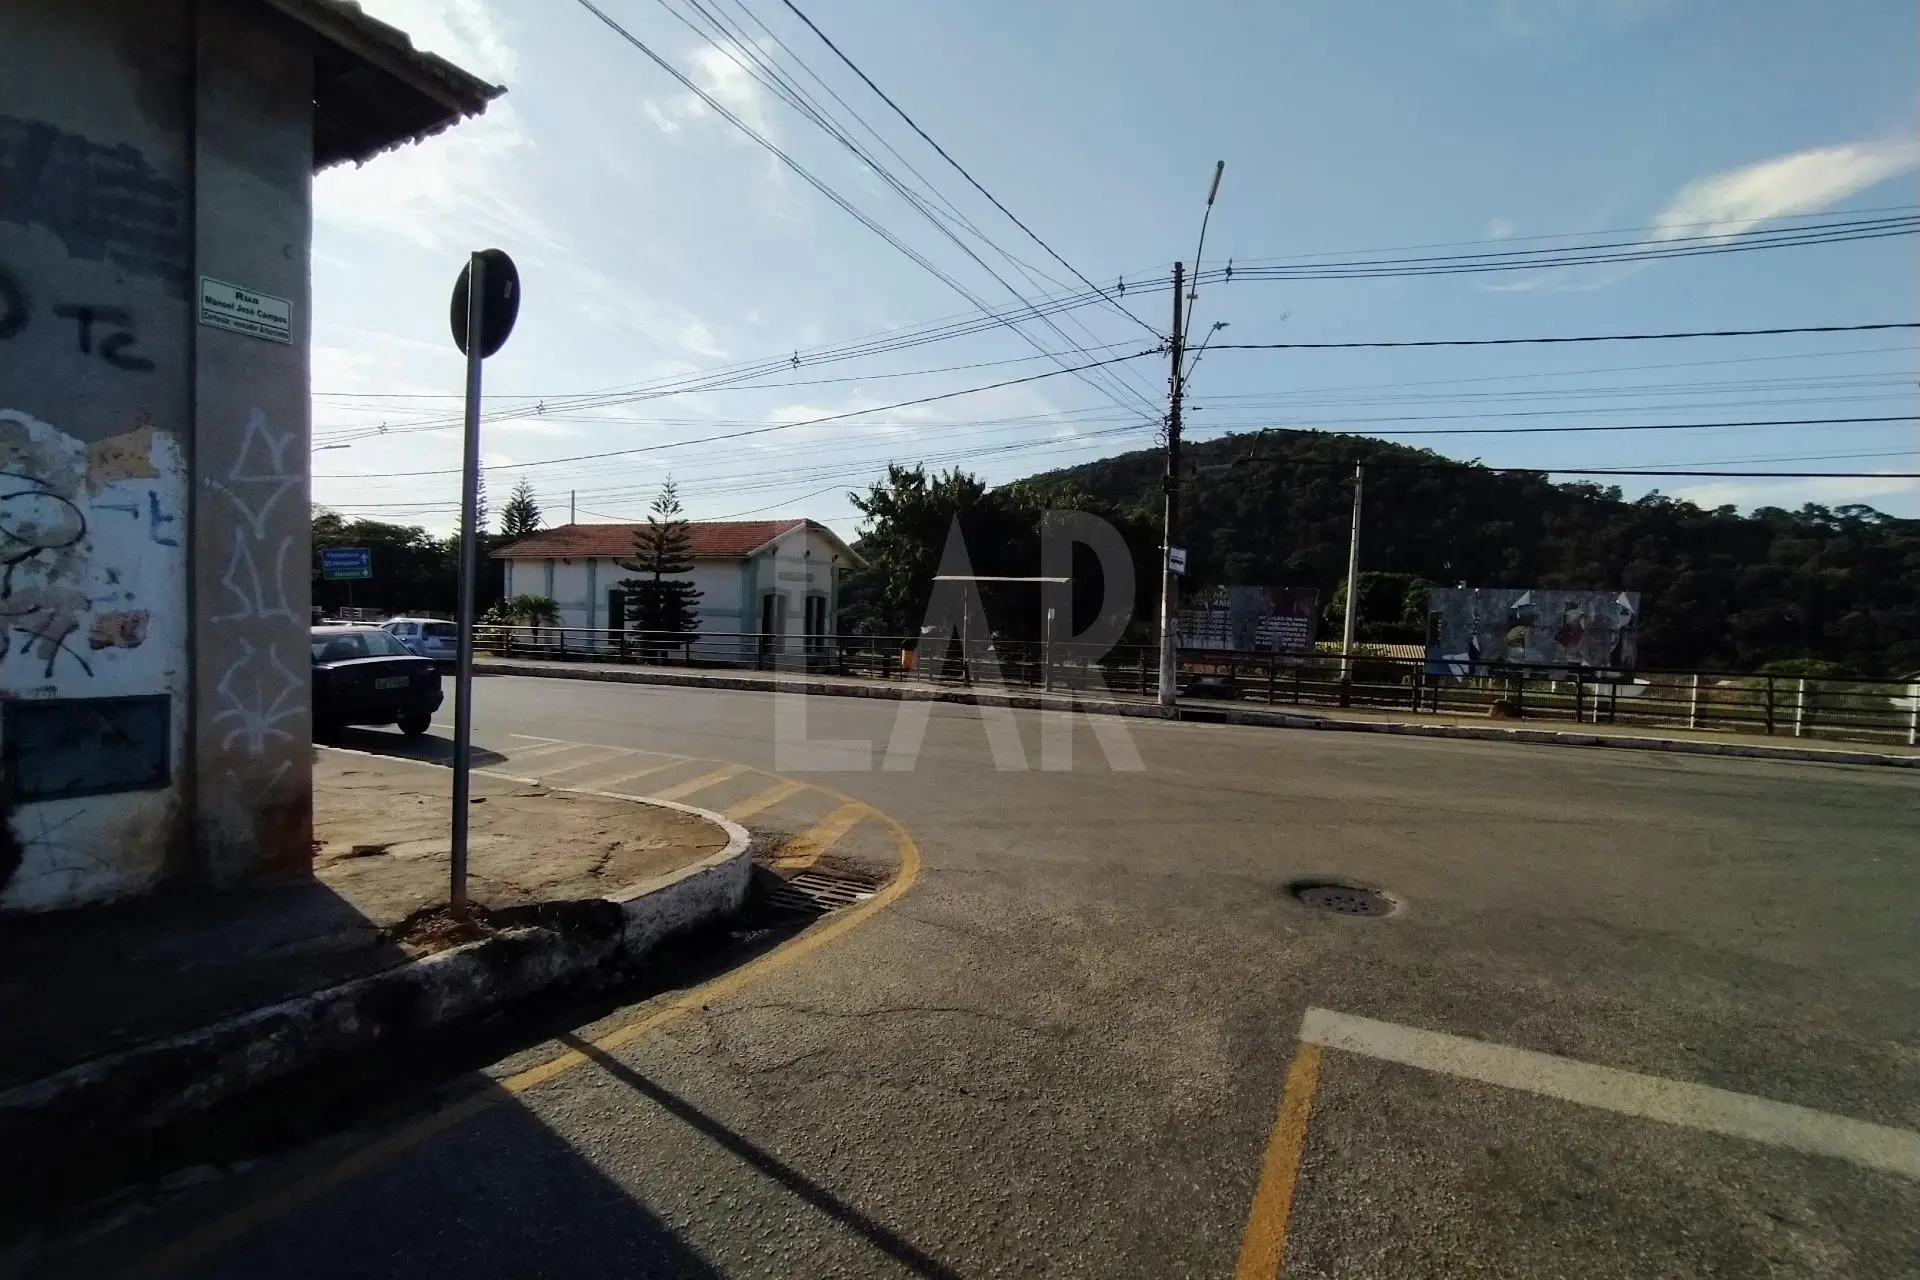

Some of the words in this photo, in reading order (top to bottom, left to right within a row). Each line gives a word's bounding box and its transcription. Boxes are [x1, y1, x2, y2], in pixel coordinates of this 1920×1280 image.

[236, 292, 259, 304] Rua
[205, 296, 235, 309] Manoel
[257, 310, 287, 323] Campos
